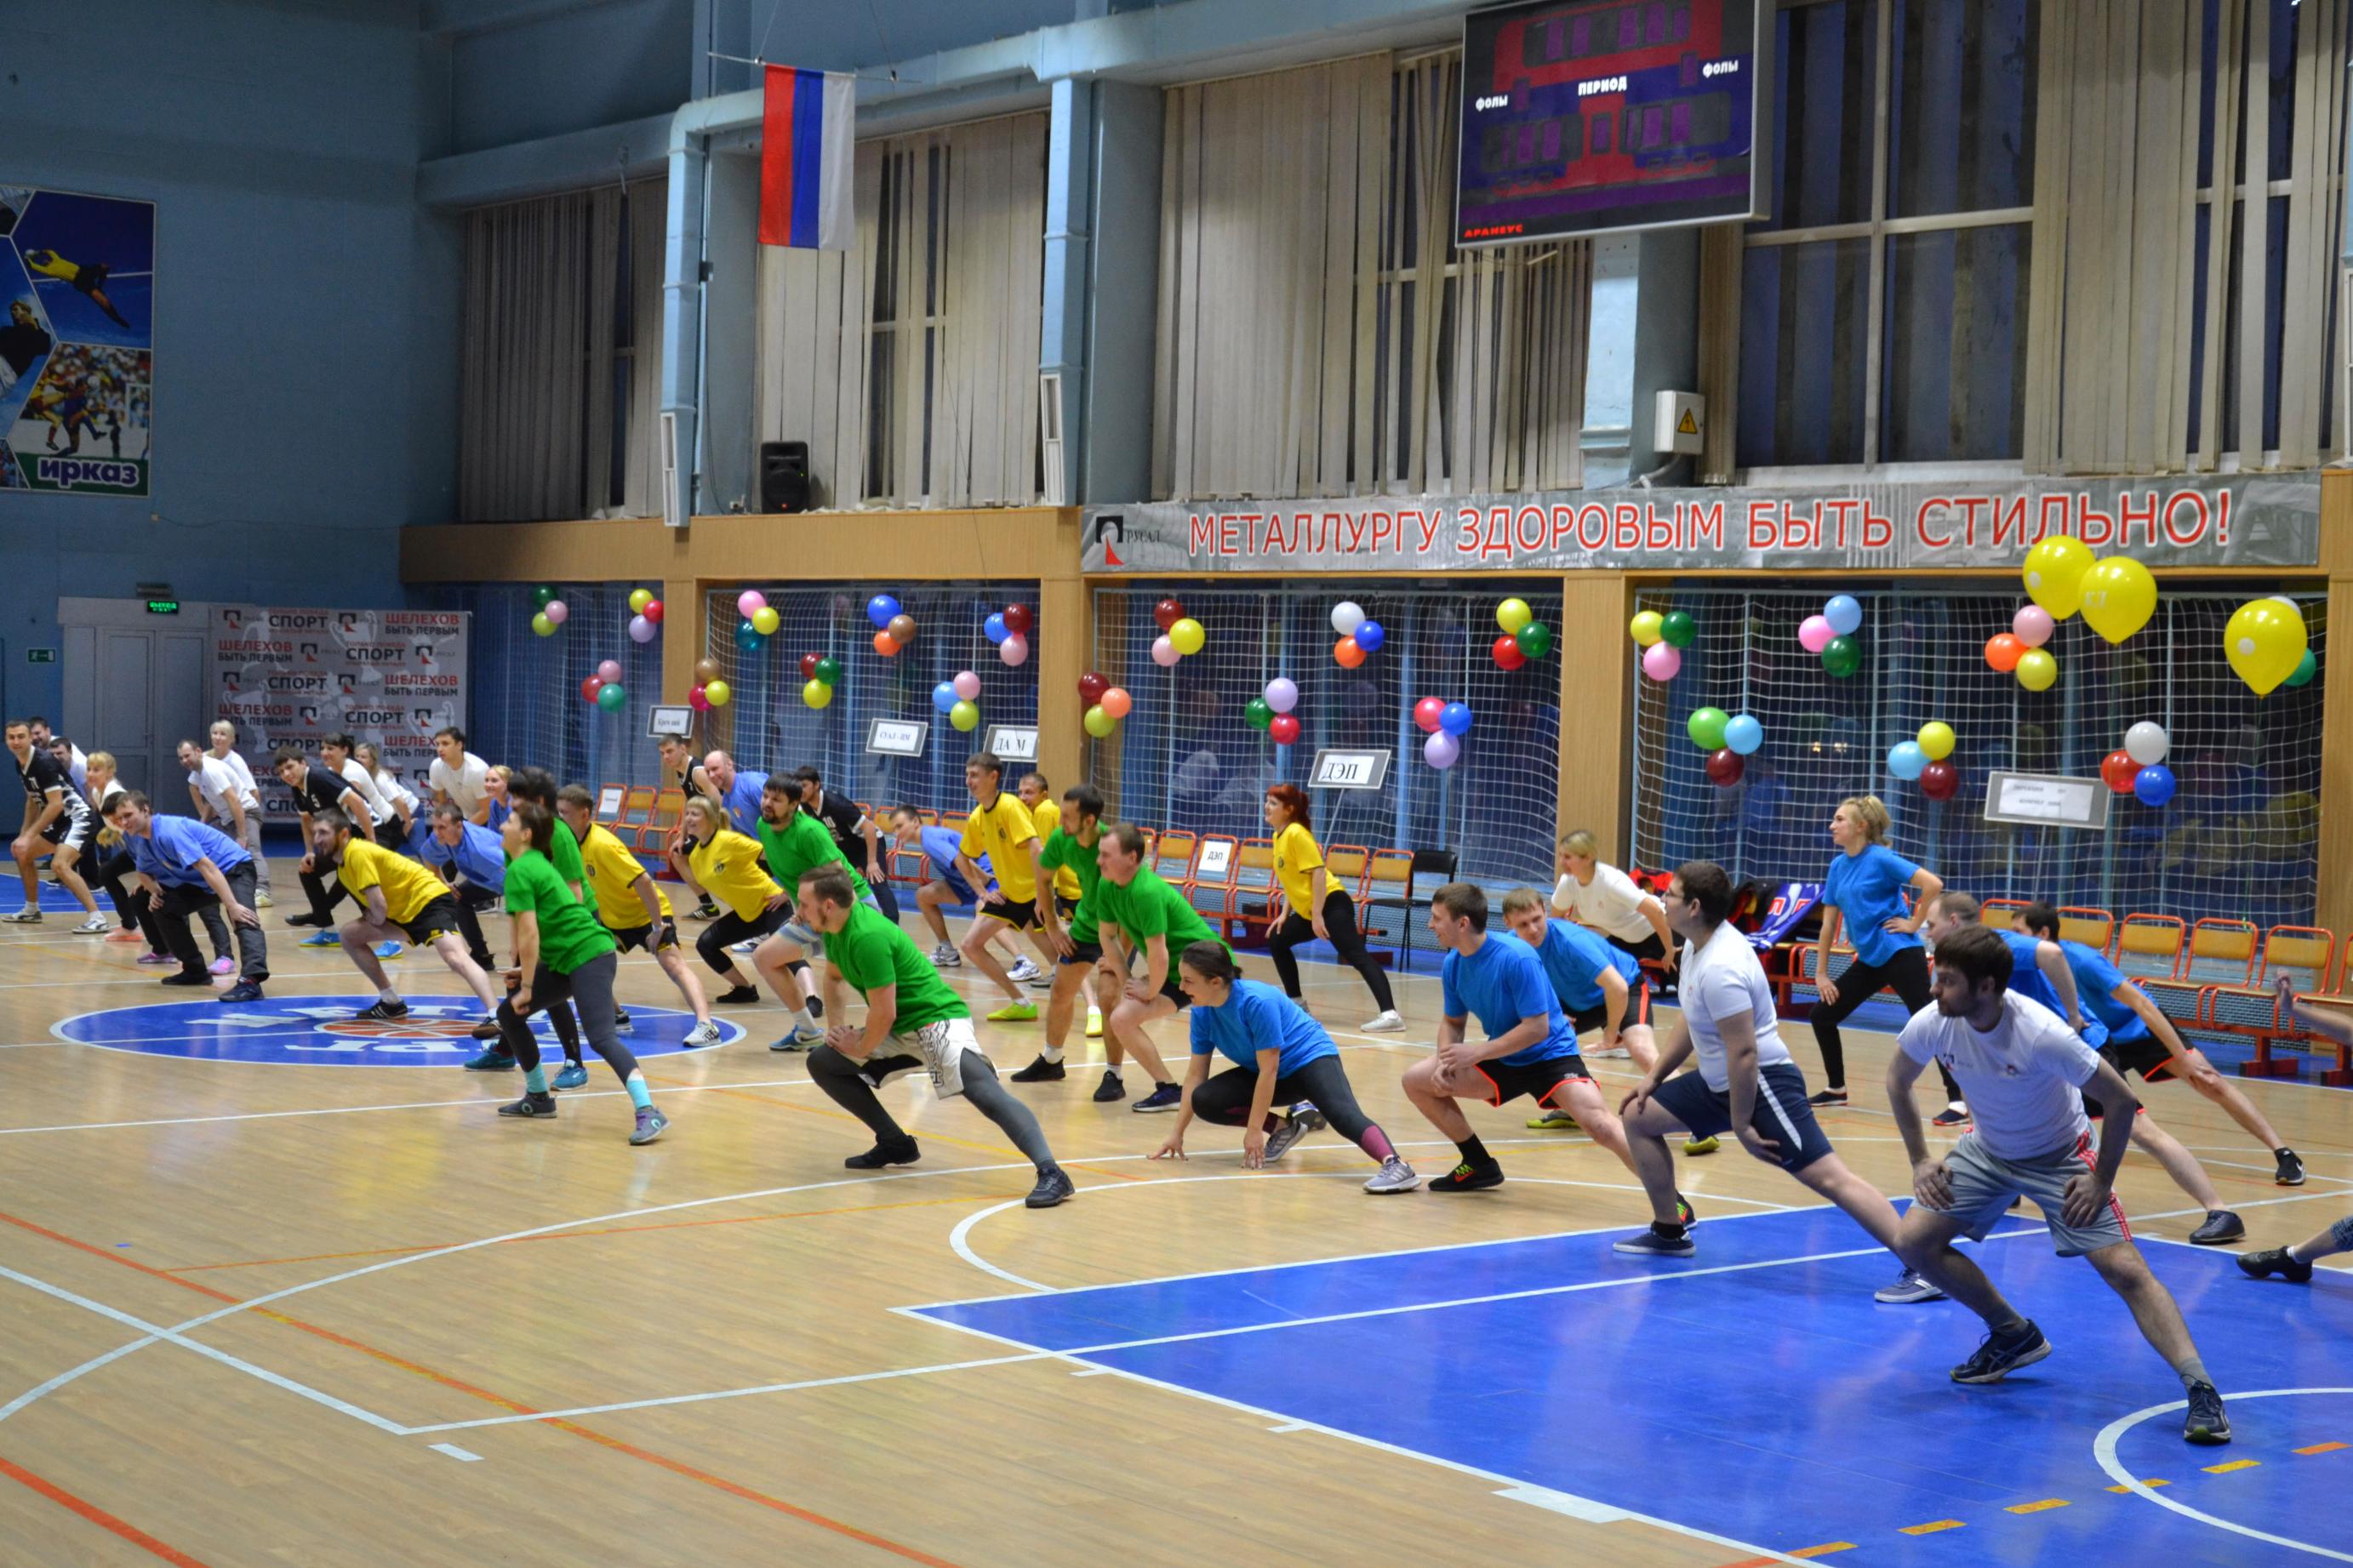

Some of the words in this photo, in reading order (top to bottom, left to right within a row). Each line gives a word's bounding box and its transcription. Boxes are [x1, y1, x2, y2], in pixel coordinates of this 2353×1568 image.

[1578, 76, 1627, 96] ПЕРИОД
[39, 459, 139, 488] ирказ
[1189, 510, 1442, 556] МЕТАЛЛУРГУ
[1456, 502, 1724, 561] ЗДОРОВЫМ
[1747, 499, 1894, 550] БЫТЬ
[1916, 488, 2232, 549] СТИЛЬНО!
[269, 615, 328, 628] СПОРТ
[385, 613, 460, 625] ШЕЛЕХОВ
[386, 625, 414, 635] БЫТЬ
[416, 626, 459, 636] ПЕРВЫМ
[218, 640, 293, 652] ШЕЛЕХОВ
[218, 653, 247, 661] БЫТЬ
[249, 653, 293, 662] ПЕРВЫМ
[346, 648, 404, 660] СПОРТ
[268, 677, 327, 689] СПОРТ
[385, 675, 458, 686] ШЕЛЕХОВ
[385, 687, 413, 696] БЫТЬ
[415, 687, 458, 697] ПЕРВЫМ
[218, 704, 293, 716] ШЕЛЕХОВ
[249, 717, 293, 726] ПЕРВЫМ
[346, 711, 404, 723] СПОРТ
[383, 749, 411, 757] БЫТЬ
[1322, 762, 1358, 781] ДЭП
[1208, 851, 1224, 861] ДЭП
